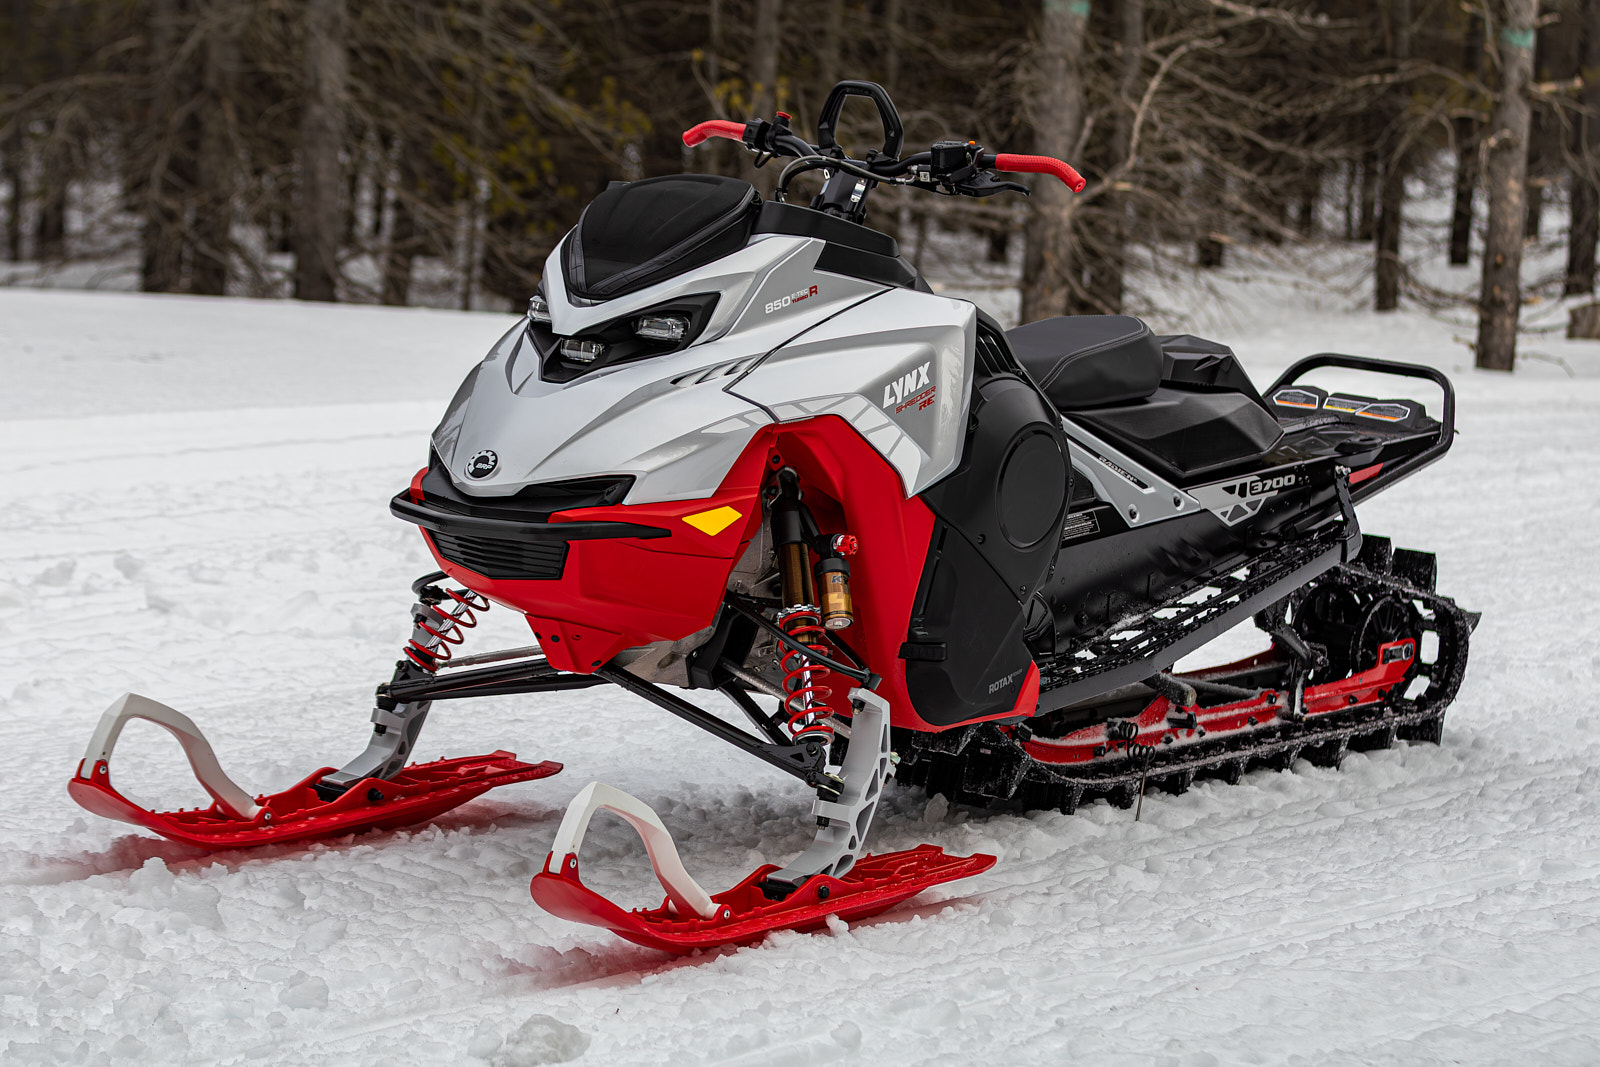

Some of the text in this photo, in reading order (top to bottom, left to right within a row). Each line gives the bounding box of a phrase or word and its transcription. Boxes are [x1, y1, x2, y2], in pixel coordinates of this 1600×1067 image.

[809, 284, 818, 297] R
[765, 295, 791, 314] 850
[883, 361, 931, 410] LYNX
[895, 385, 937, 414] SHREDDER
[918, 394, 936, 411] RE
[475, 462, 493, 470] BRP
[1250, 474, 1296, 494] 3700
[988, 673, 1013, 695] ROTAX
